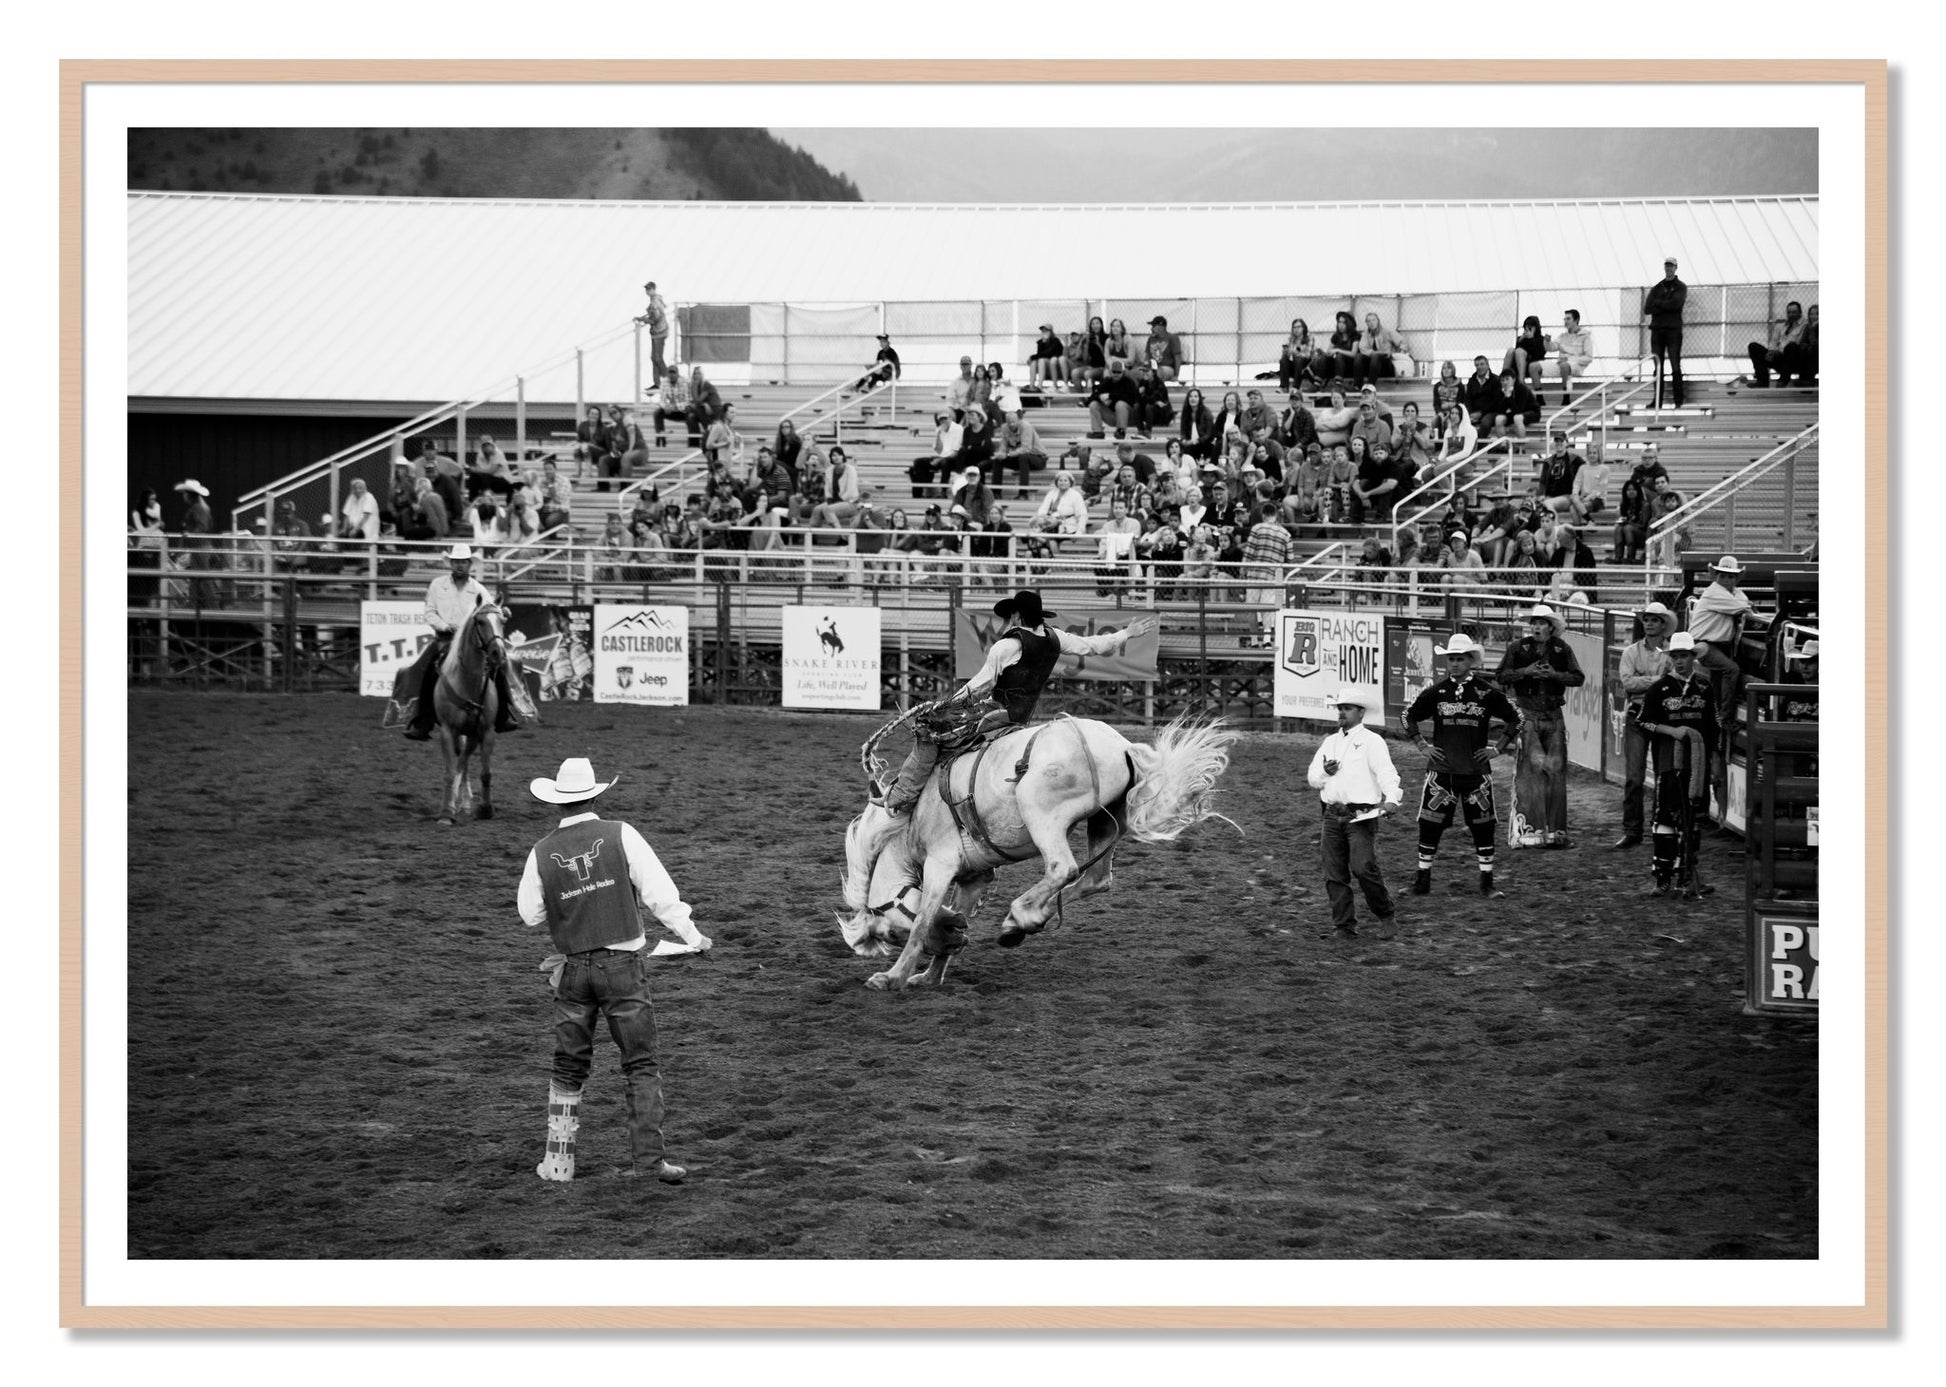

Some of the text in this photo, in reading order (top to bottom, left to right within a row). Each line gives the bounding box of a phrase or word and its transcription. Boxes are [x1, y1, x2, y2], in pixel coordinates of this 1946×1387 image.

[1294, 621, 1316, 633] BIG
[1321, 618, 1379, 644] RANCH
[601, 635, 684, 652] CASTLEROCK
[1287, 632, 1317, 666] R
[784, 659, 878, 670] SNAKE RIVER
[1322, 653, 1337, 667] AND
[1339, 645, 1379, 684] HOME
[639, 672, 668, 688] Jeep
[797, 680, 868, 690] Life, Well Played
[560, 879, 615, 900] Jackson Hole Rodeo
